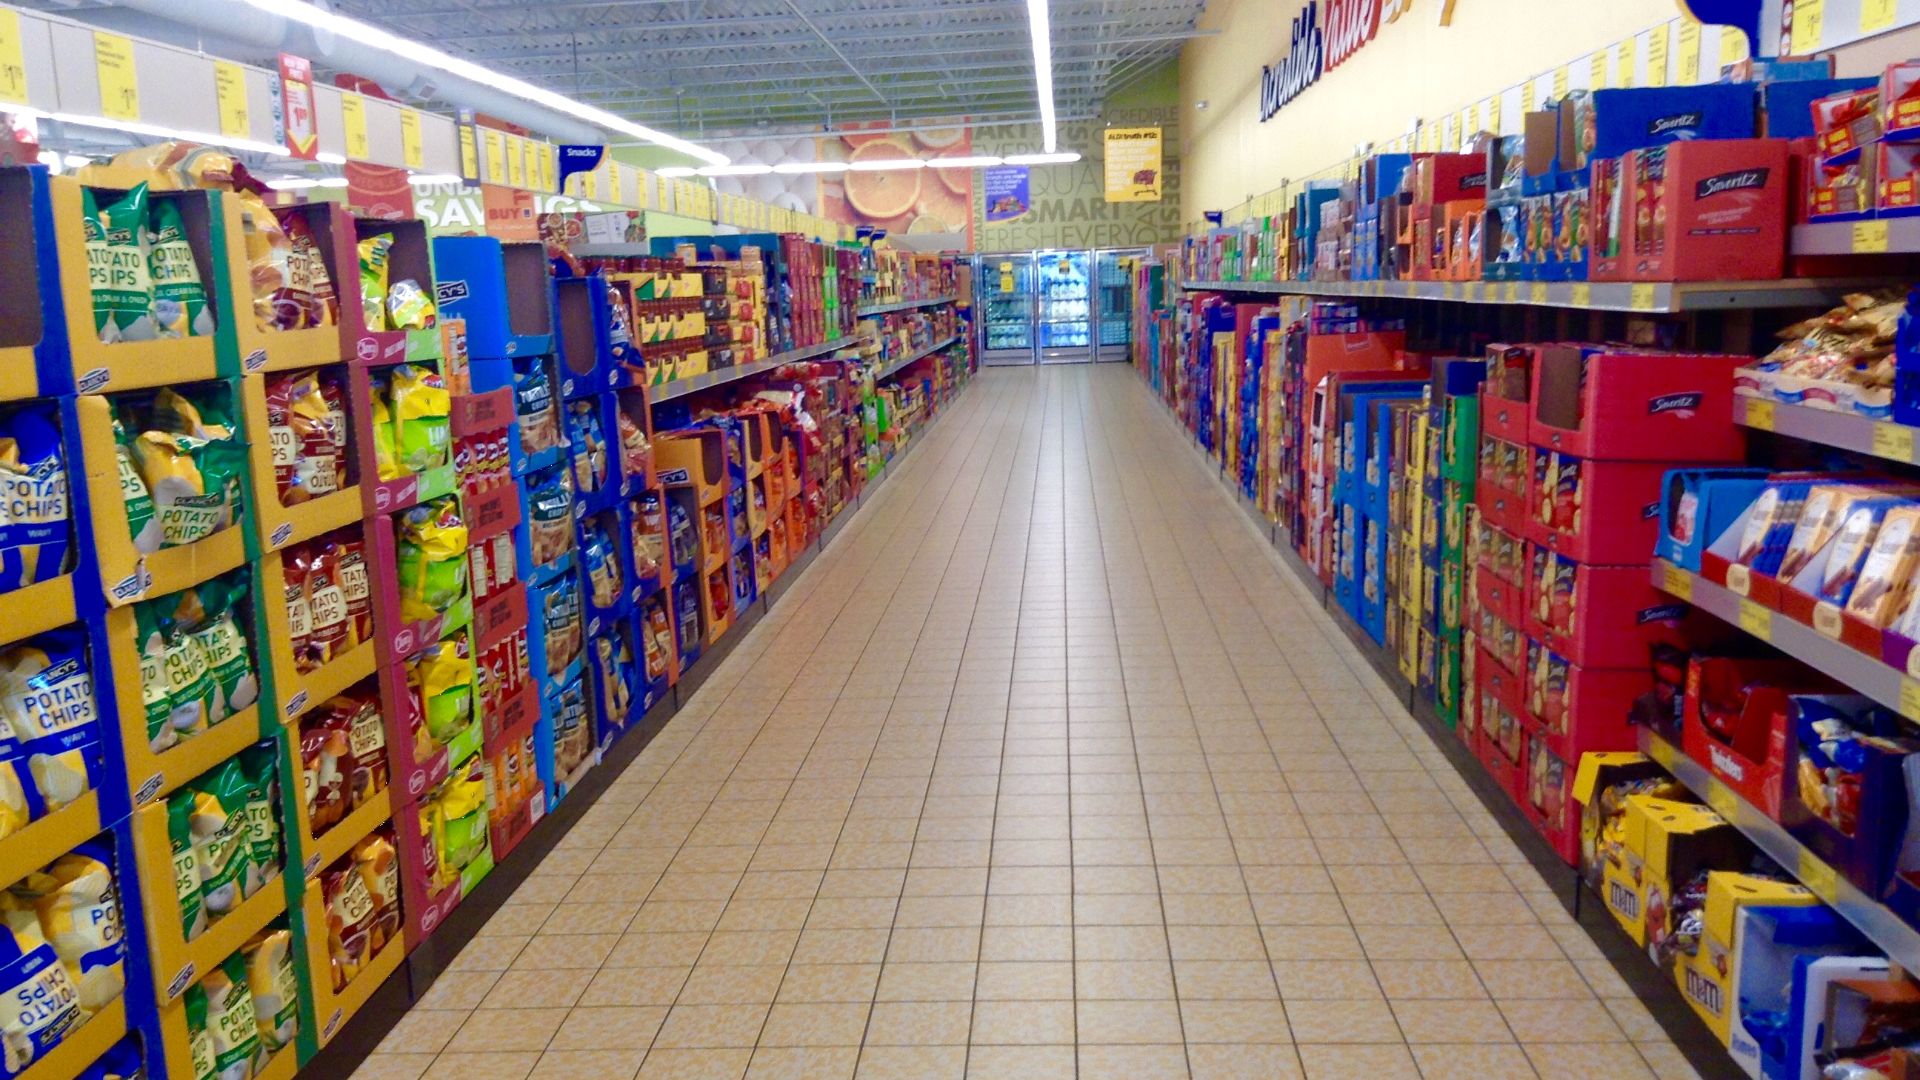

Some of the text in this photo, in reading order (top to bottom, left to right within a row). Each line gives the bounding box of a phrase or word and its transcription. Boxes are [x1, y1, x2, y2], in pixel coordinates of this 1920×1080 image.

[567, 148, 596, 157] Snacks
[162, 509, 219, 525] POTATO
[23, 682, 92, 713] POTATO
[38, 700, 91, 729] CHIPS
